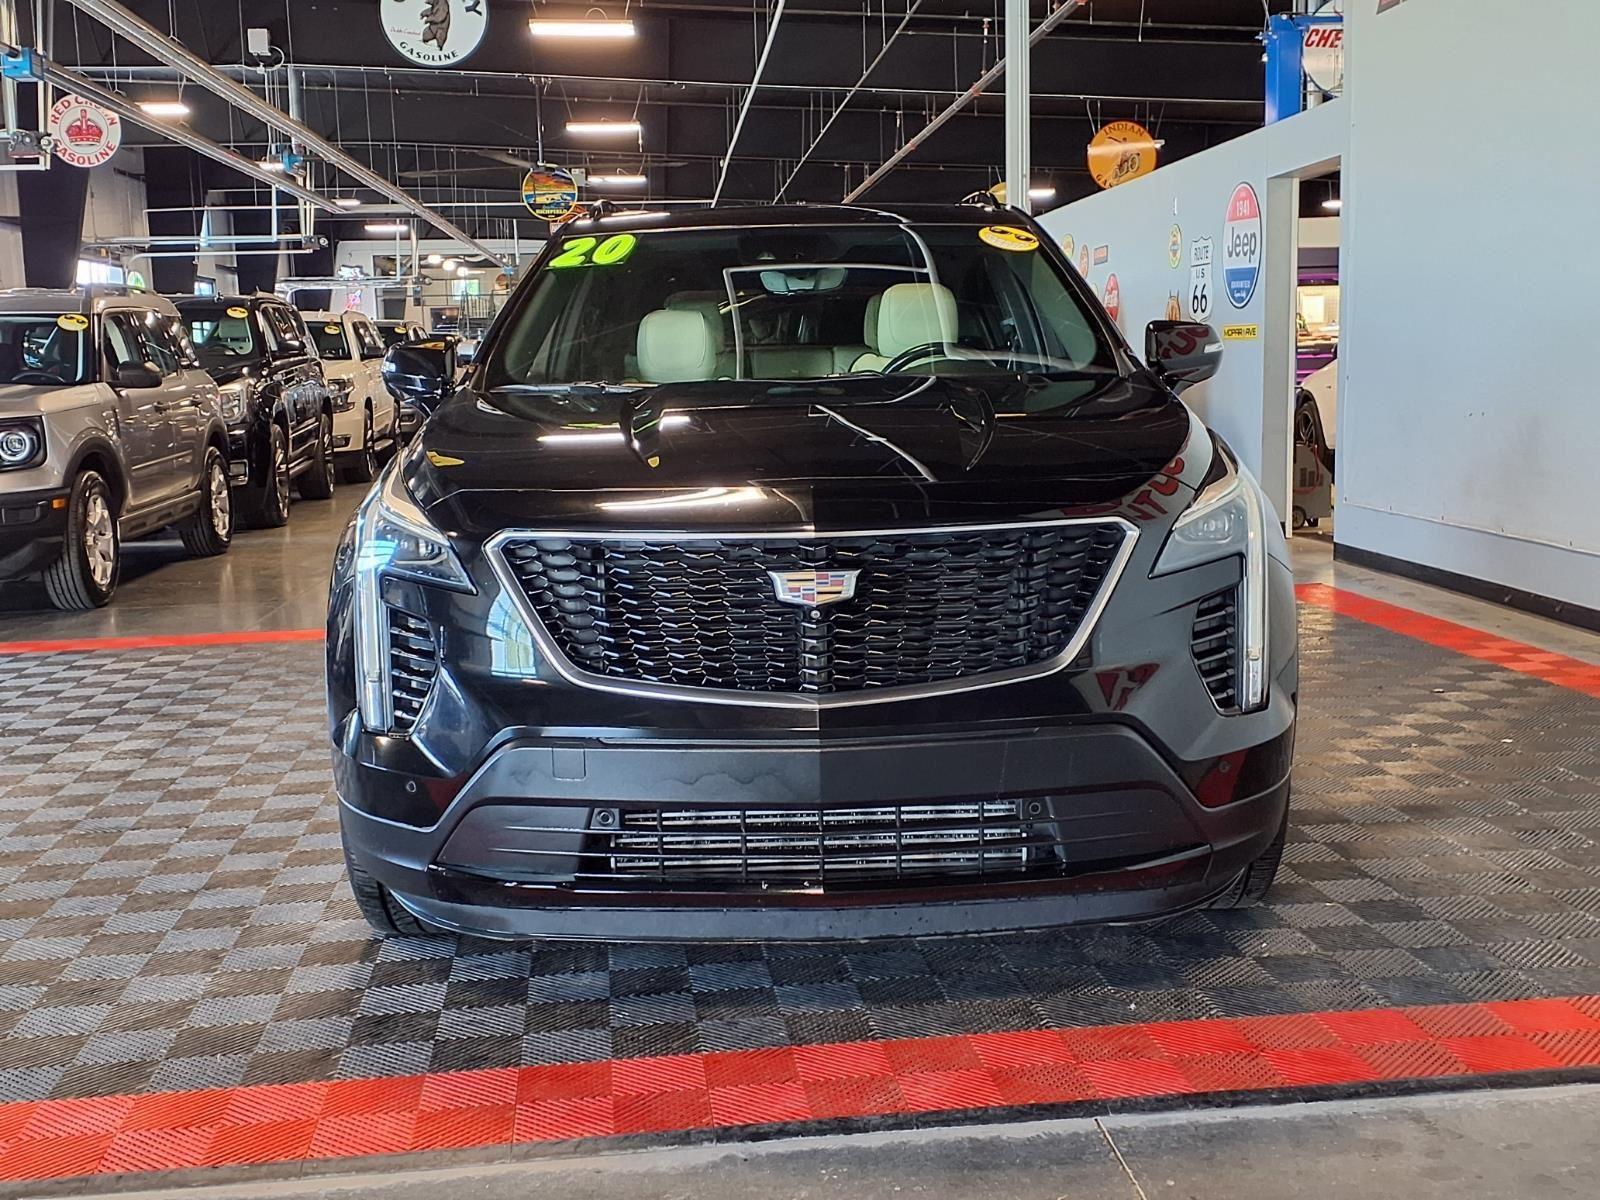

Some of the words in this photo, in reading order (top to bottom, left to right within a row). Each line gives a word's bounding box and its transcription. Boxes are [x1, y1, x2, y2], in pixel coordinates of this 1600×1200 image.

[399, 41, 459, 62] GASOLINE
[51, 99, 71, 124] RED
[1104, 123, 1145, 137] INDIAN
[1236, 200, 1250, 217] 1941
[548, 234, 636, 267] 20
[1194, 245, 1209, 261] ROUTE
[1227, 226, 1257, 262] Jeep
[1192, 283, 1208, 314] 66
